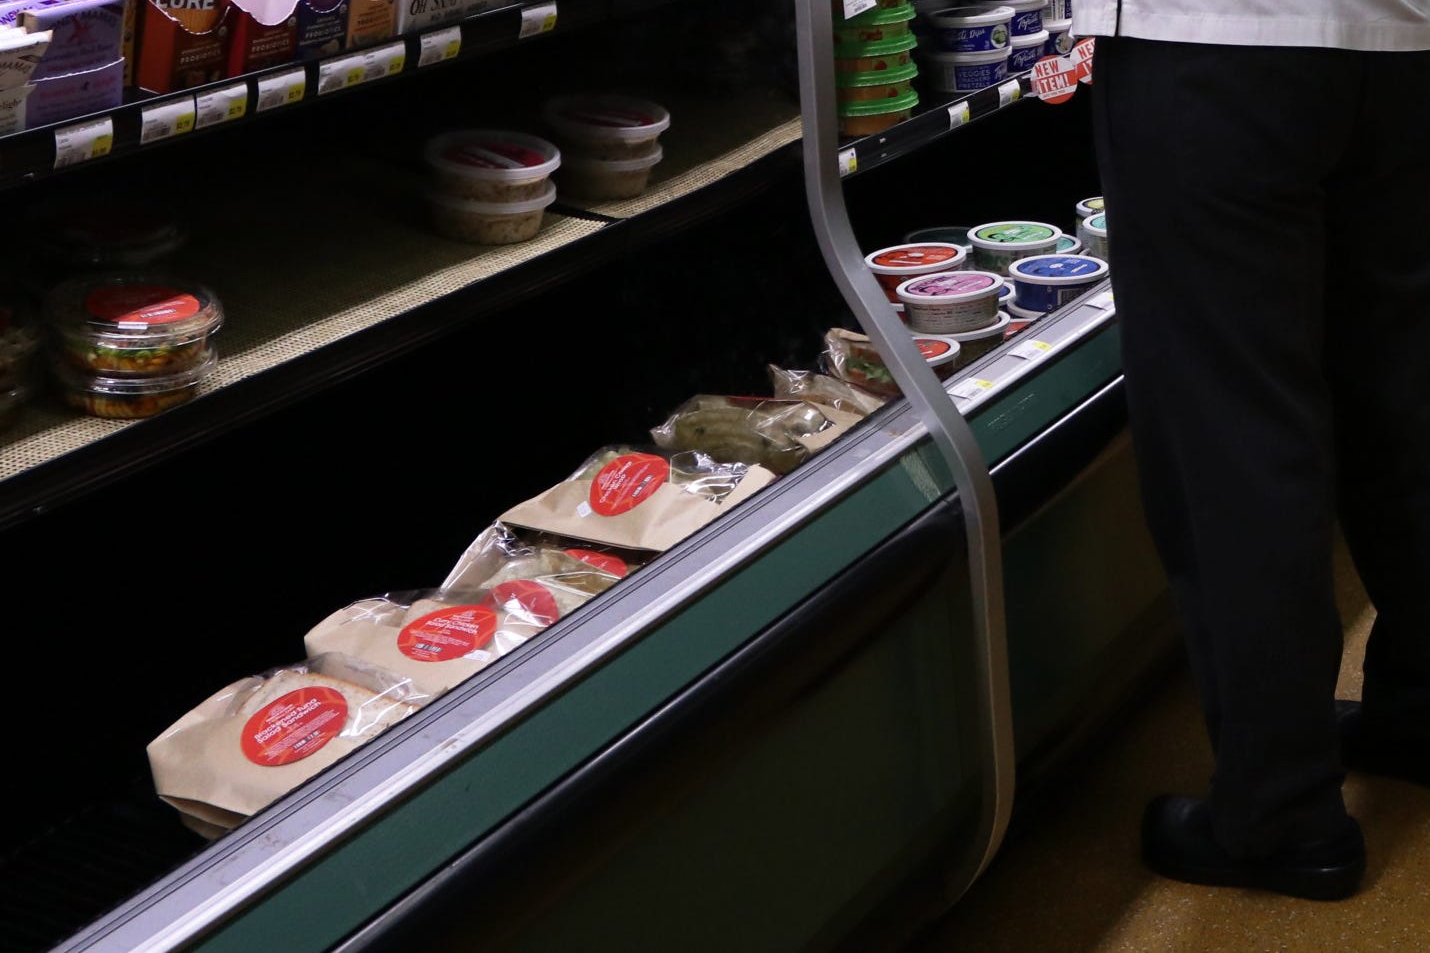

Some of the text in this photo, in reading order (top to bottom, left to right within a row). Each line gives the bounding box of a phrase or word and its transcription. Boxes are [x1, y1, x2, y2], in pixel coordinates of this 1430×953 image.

[251, 38, 290, 53] PROBIOTICS
[180, 48, 222, 64] PROBIOTICS
[1034, 61, 1059, 77] NEW
[1036, 75, 1070, 94] ITEM!
